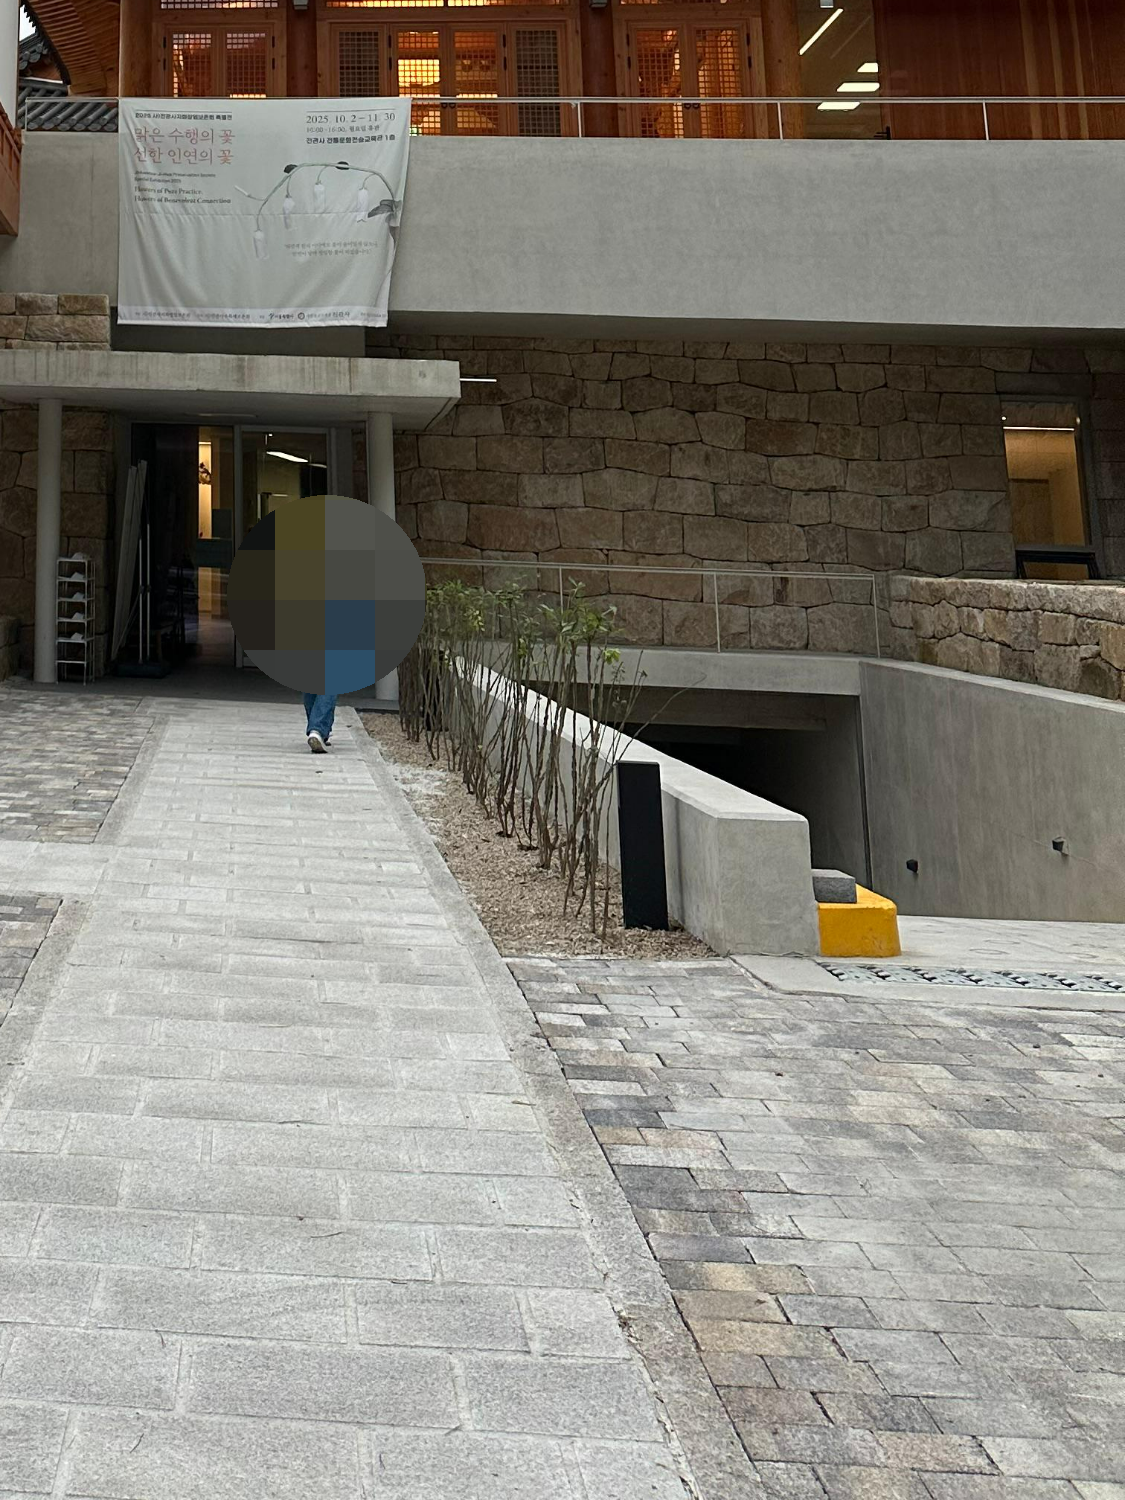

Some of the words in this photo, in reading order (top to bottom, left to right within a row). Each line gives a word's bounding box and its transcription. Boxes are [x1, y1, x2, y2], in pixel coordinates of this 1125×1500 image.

[135, 126, 165, 143] 맑은
[168, 127, 214, 145] 수행의
[219, 129, 236, 145] 꽃
[134, 146, 164, 164] 선한
[167, 147, 213, 165] 인연의
[217, 149, 235, 165] 꽃
